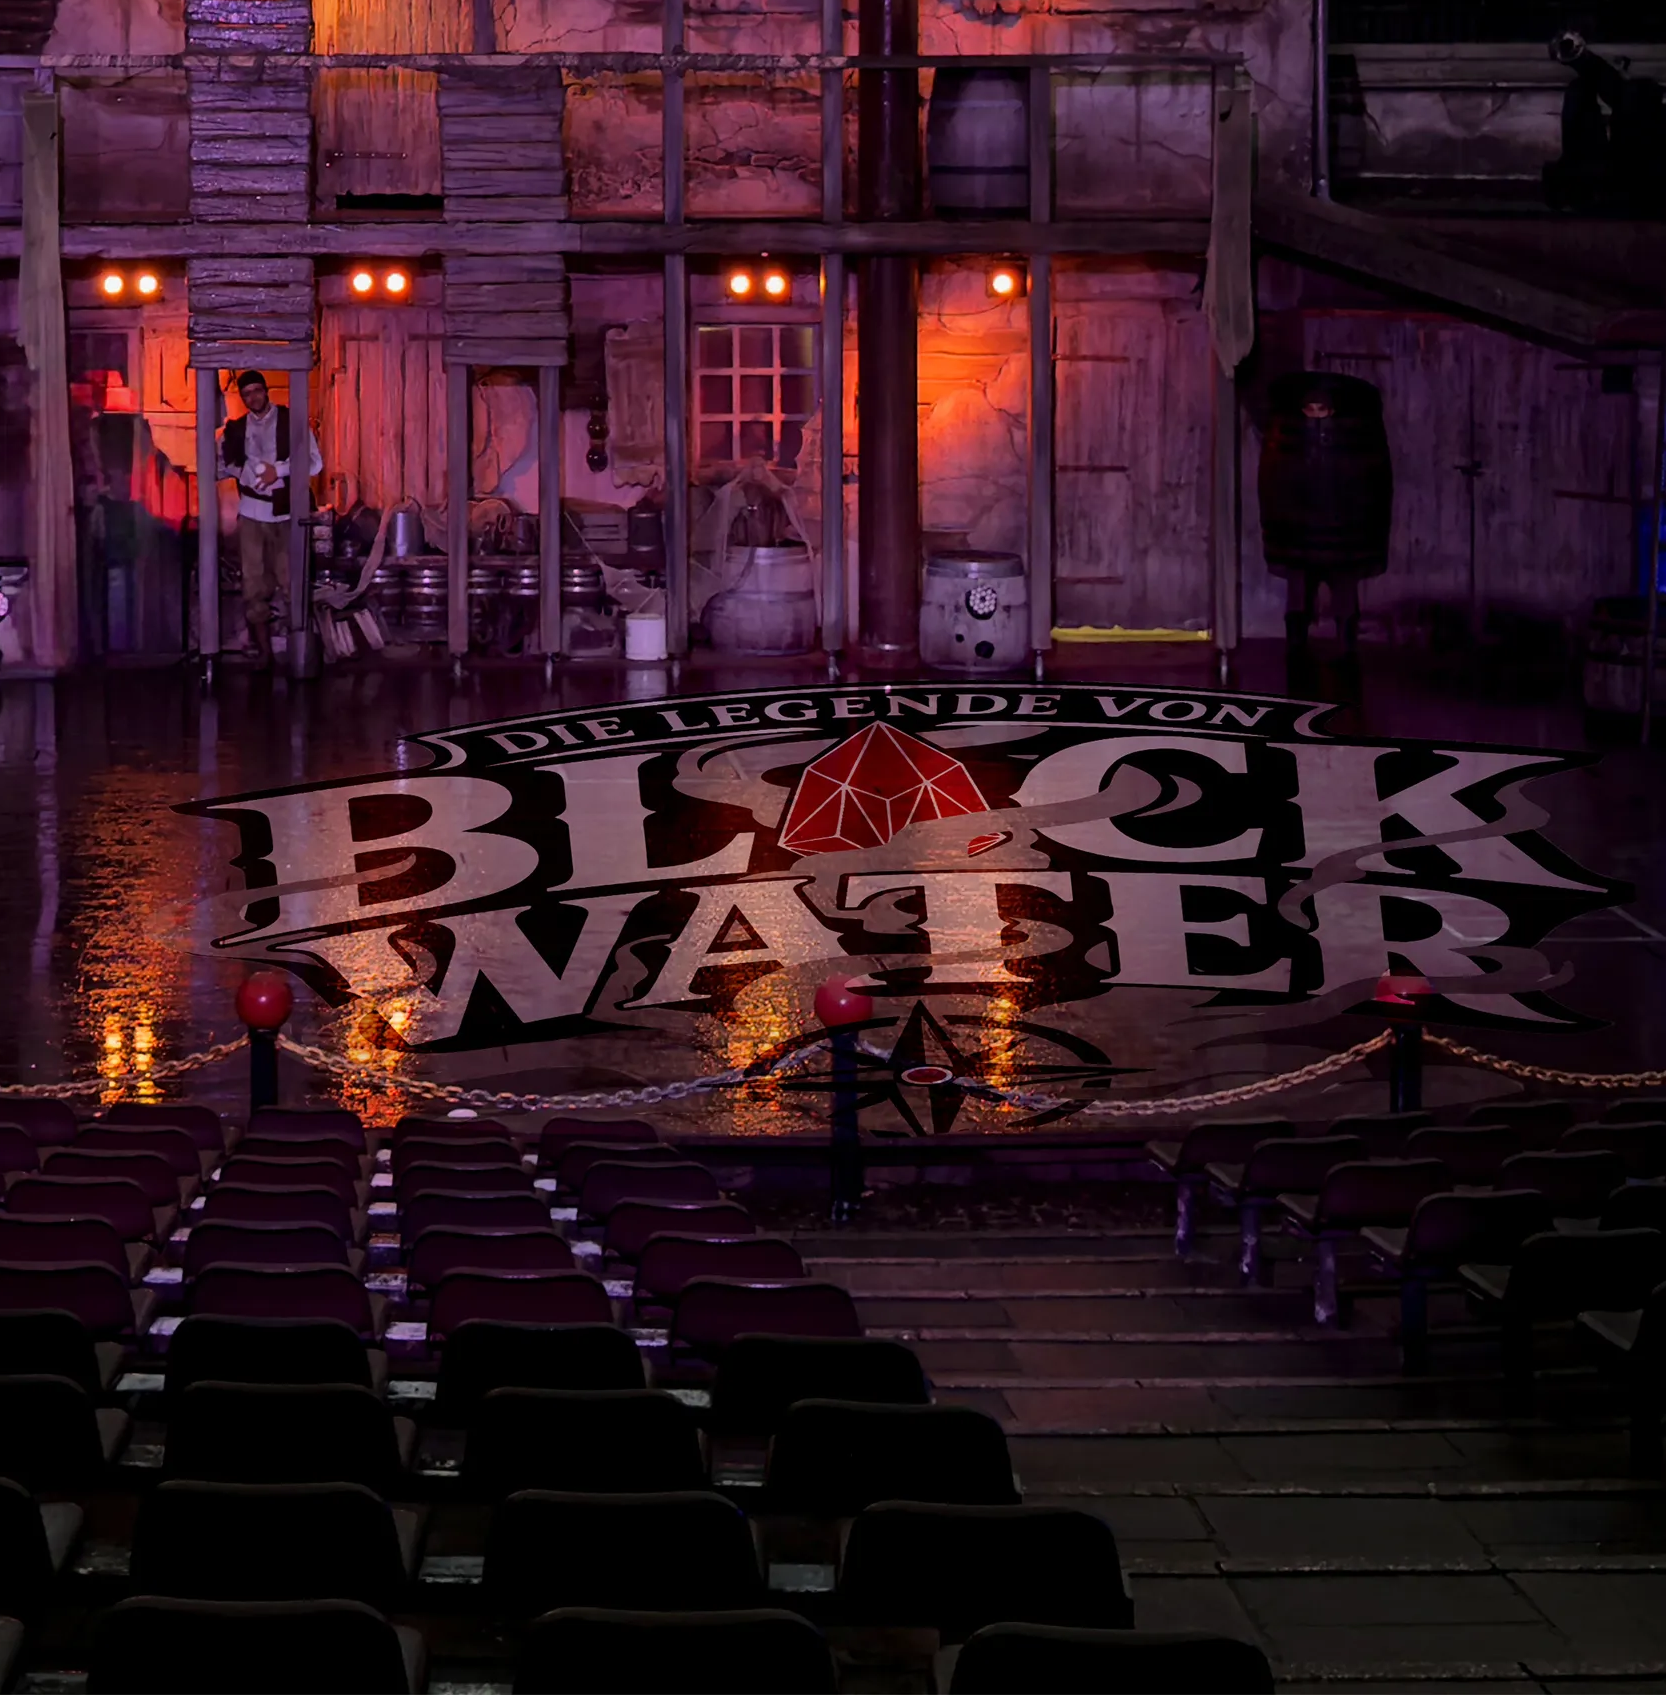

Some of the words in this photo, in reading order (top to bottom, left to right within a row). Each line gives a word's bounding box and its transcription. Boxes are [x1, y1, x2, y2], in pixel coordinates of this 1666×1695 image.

[484, 715, 635, 755] DIE
[657, 693, 1059, 732] LEGENDE
[1093, 695, 1275, 727] VON
[265, 874, 1578, 1046] WATER
